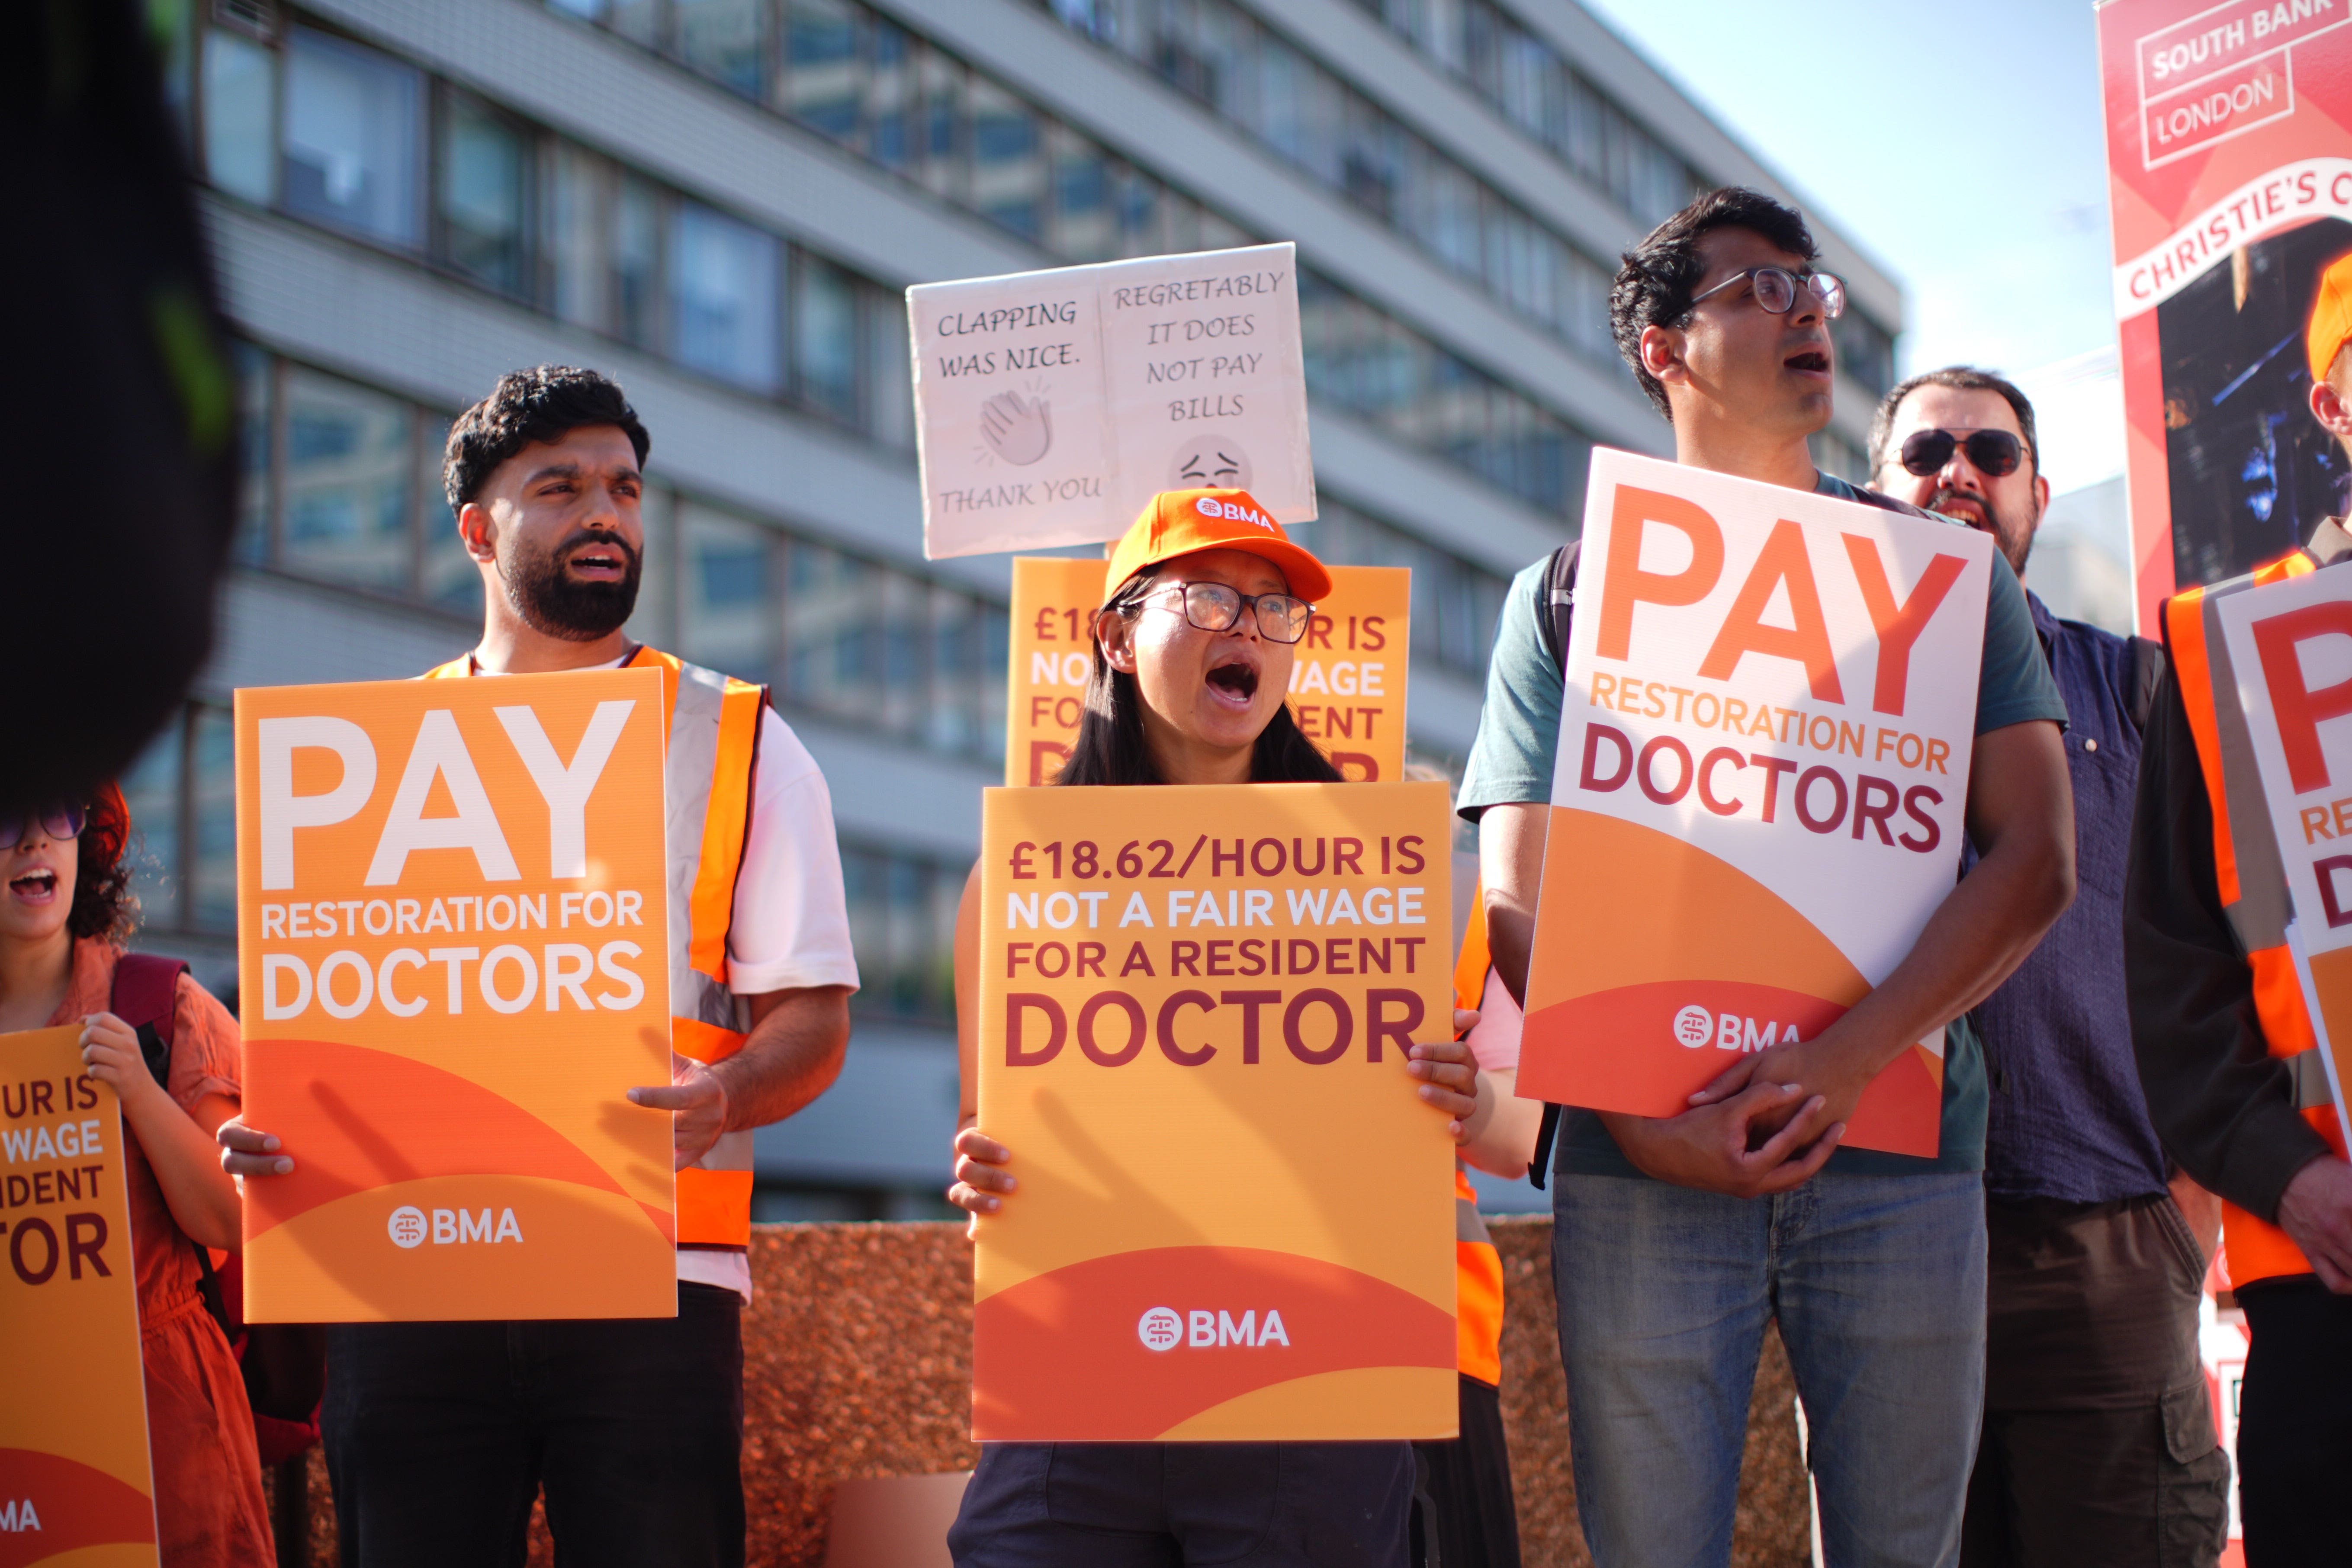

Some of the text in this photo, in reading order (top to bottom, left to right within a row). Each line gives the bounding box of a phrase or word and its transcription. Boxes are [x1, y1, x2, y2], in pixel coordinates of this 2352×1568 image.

[2153, 19, 2244, 80] SOUTH
[2156, 74, 2274, 145] LONDON
[2130, 170, 2317, 301] CHRISTIE'S
[1113, 272, 1285, 309] REGRETABLY
[939, 301, 1077, 337] CLAPPING
[1148, 315, 1255, 344] IT DOES
[939, 344, 1080, 378] WAS NICE.
[1147, 353, 1263, 384] NOT PAY
[1169, 395, 1243, 421] BILLS
[940, 477, 1102, 512] THANK YOU
[1224, 503, 1275, 533] BMA
[1596, 483, 1968, 717] PAY
[1348, 616, 1386, 652] IS
[1031, 652, 1091, 686] NO
[1031, 696, 1082, 729] FO
[1590, 672, 1950, 775] RESTORATION FOR
[258, 700, 636, 890] PAY
[1579, 722, 1944, 853] DOCTORS
[1010, 834, 1425, 880] £18.62/HOUR IS
[261, 890, 643, 938] RESTORATION FOR
[1007, 887, 1426, 929] NOT A FAIR WAGE
[1006, 937, 1426, 979] FOR A RESIDENT
[263, 940, 644, 1020] DOCTORS
[1005, 987, 1425, 1067] DOCTOR
[65, 1073, 98, 1112] IS
[1, 1120, 103, 1164] WAGE
[433, 1208, 523, 1244] BMA
[1189, 1310, 1290, 1346] BMA
[0, 1499, 42, 1532] MA
